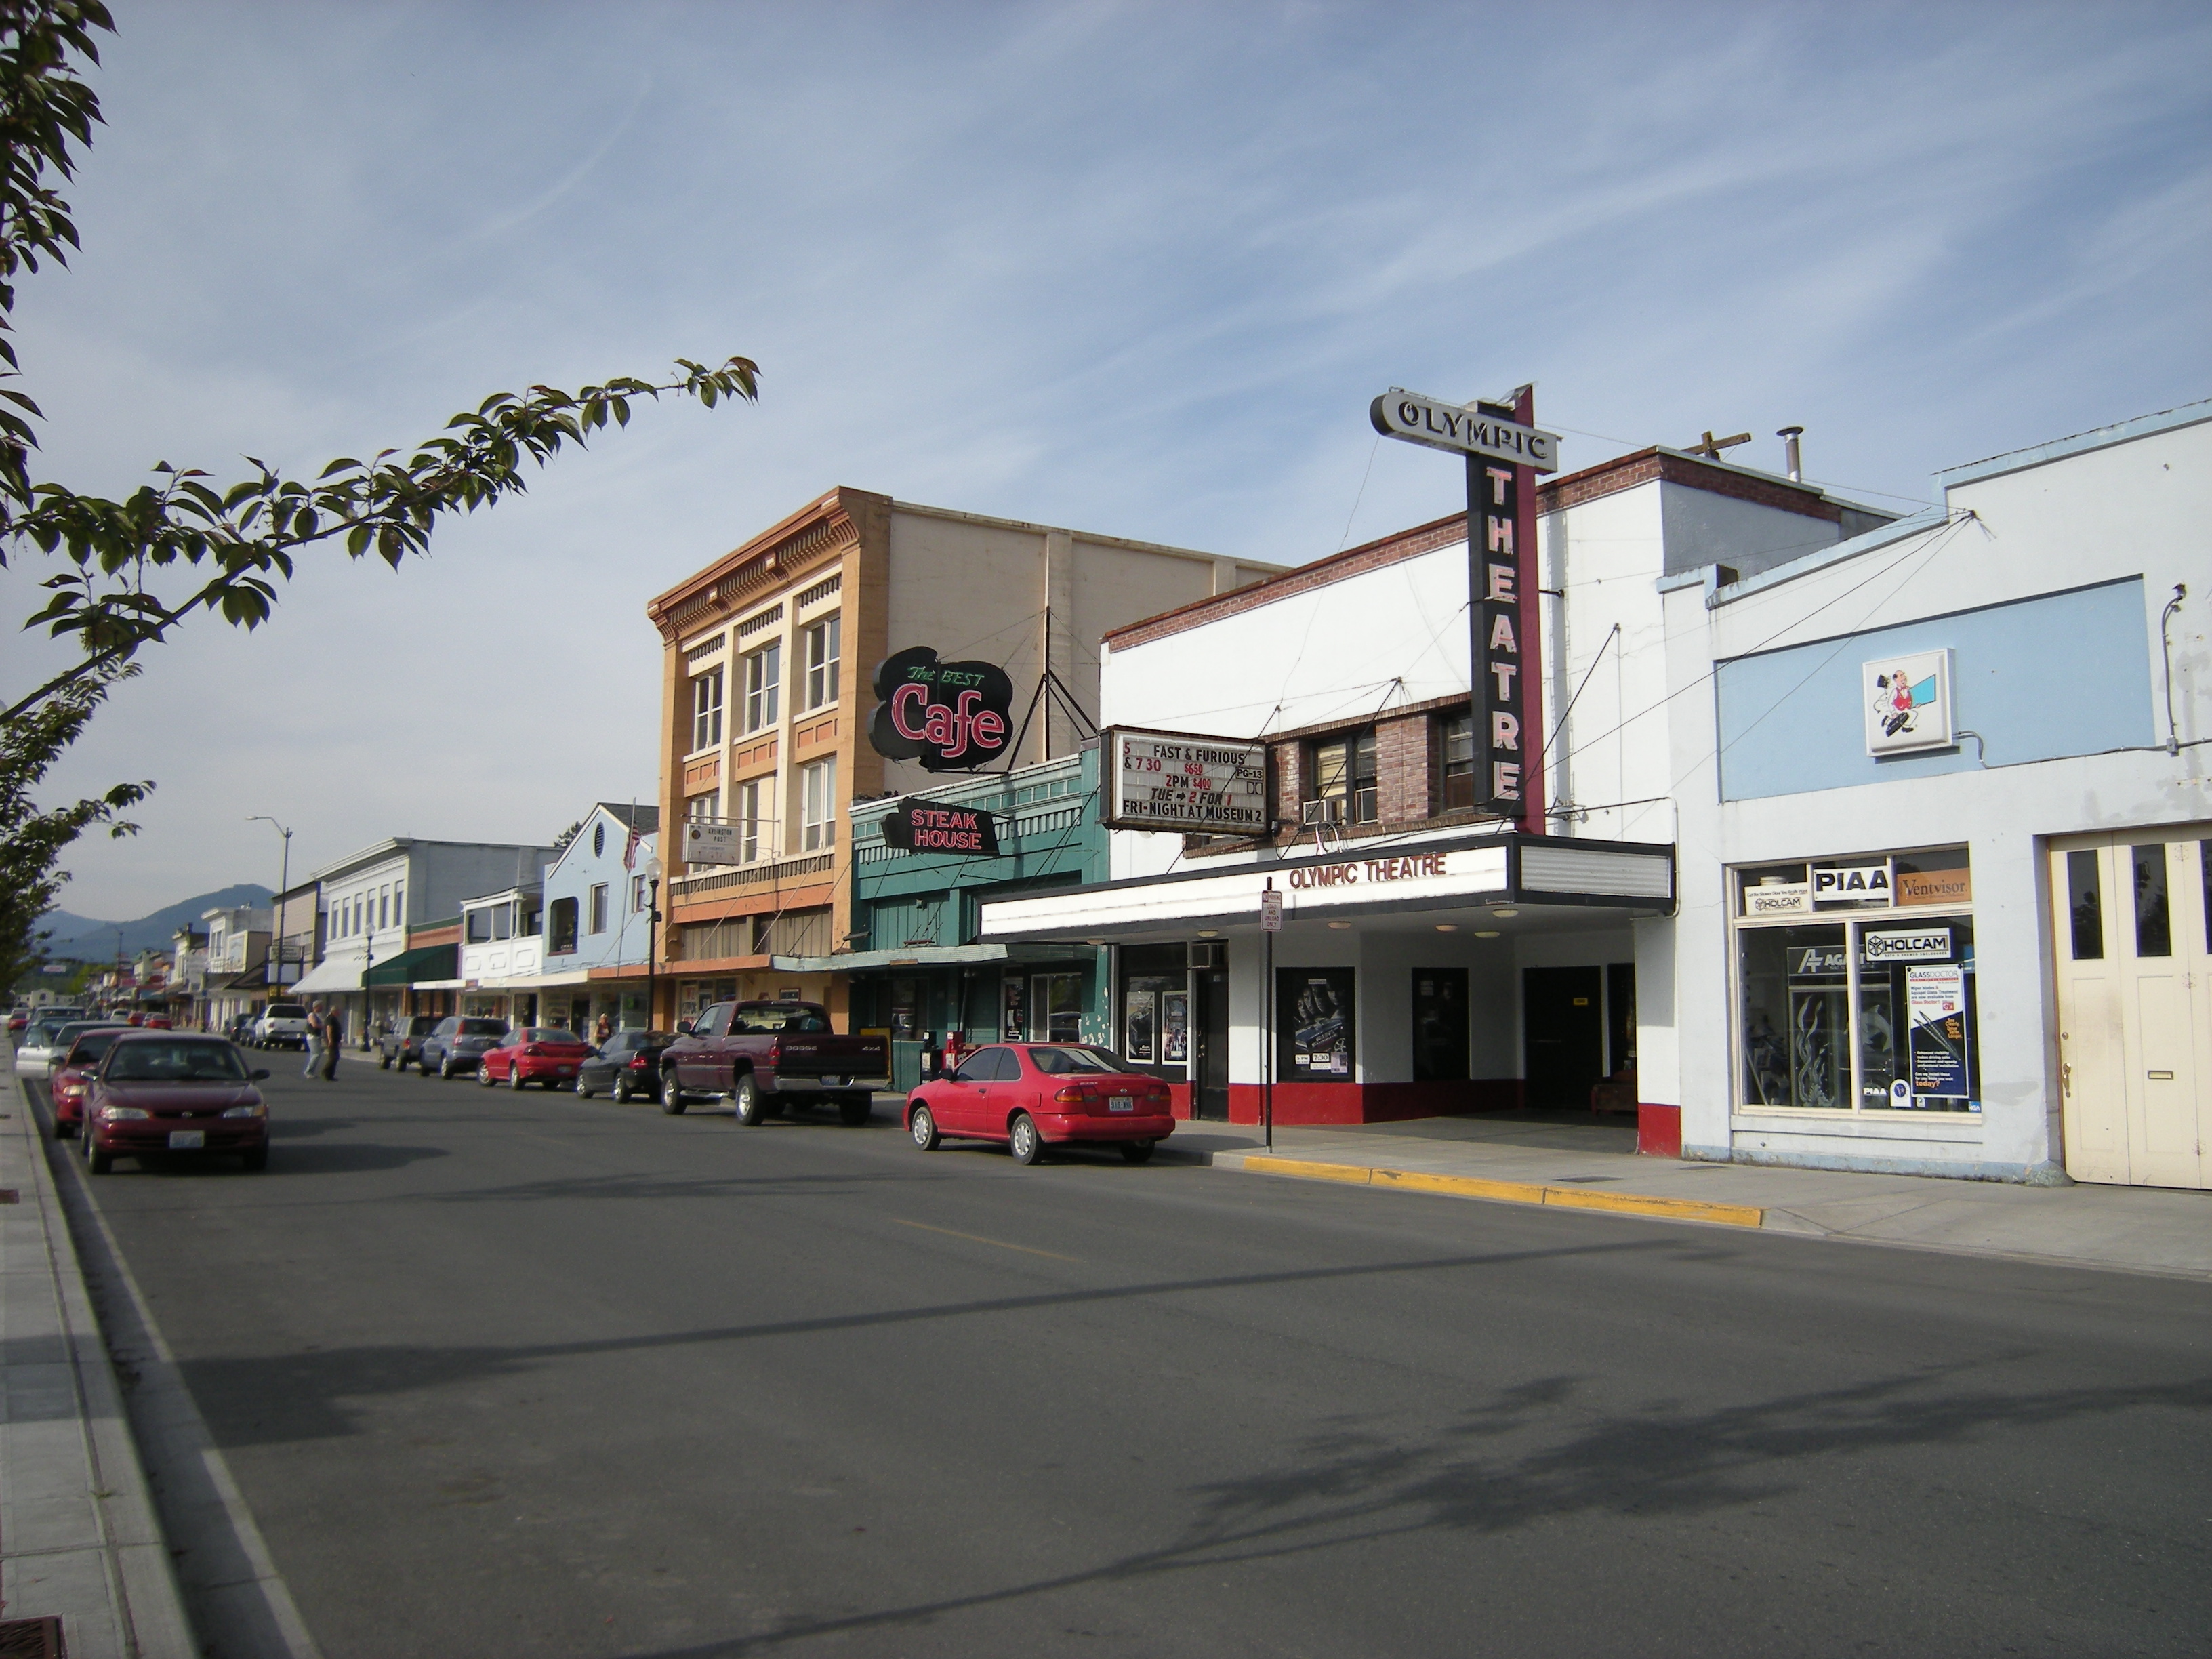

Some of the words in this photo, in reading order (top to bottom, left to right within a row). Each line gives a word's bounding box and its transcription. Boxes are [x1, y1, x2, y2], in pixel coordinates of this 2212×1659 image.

[1398, 401, 1548, 459] OLYMPIC
[1486, 466, 1521, 801] THEATRE
[907, 666, 936, 682] The
[939, 670, 985, 687] BEST
[890, 683, 1004, 758] Cafe
[1124, 742, 1130, 754] 5
[1154, 745, 1181, 759] FAST
[1185, 748, 1192, 760] &
[1196, 750, 1245, 764] FURIOUS
[1124, 757, 1132, 769] &
[1237, 769, 1263, 779] PG-13
[1151, 788, 1174, 801] TUE
[1189, 791, 1197, 803] 2
[1200, 792, 1224, 805] FOR
[1226, 794, 1232, 806] 1
[911, 808, 977, 830] STEAK
[1188, 805, 1203, 818] AT
[1206, 806, 1252, 821] MUSEUM
[1256, 810, 1261, 821] 2
[914, 830, 982, 851] HOUSE
[1290, 863, 1357, 889] OLYMPIC
[1364, 853, 1446, 882] THEATRE
[1816, 870, 1888, 892] PIAA
[1903, 879, 1965, 896] Ventvisor
[1765, 899, 1800, 907] HOLCAM
[1884, 937, 1946, 951] HOLCAM
